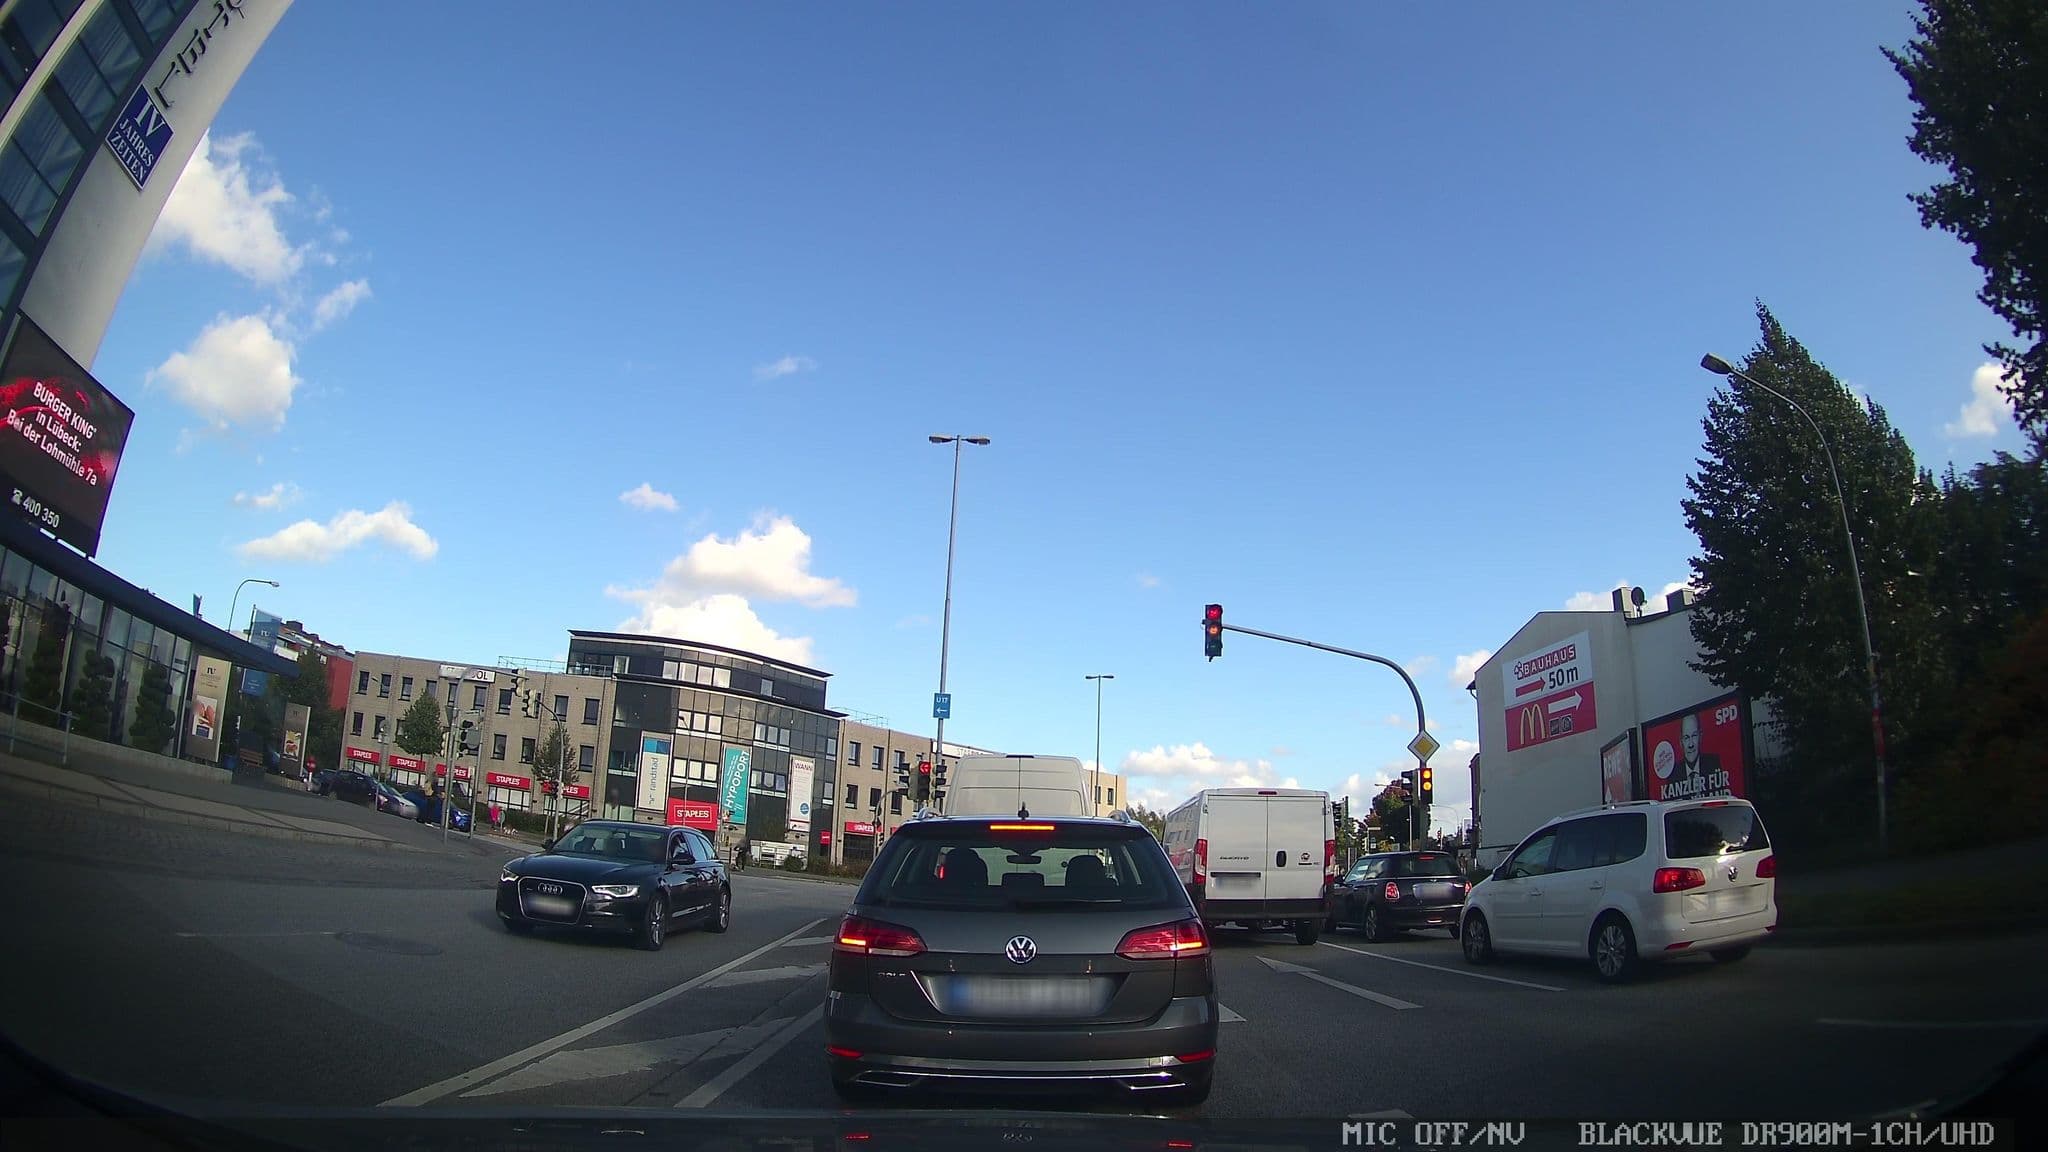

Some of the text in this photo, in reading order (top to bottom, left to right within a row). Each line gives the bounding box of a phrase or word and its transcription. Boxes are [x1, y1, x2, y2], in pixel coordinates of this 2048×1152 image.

[135, 97, 165, 137] IV
[111, 131, 147, 181] ZEITEN
[120, 119, 154, 167] JAHRES
[33, 381, 72, 423] BURGER
[36, 408, 82, 453] in Lübeck:
[6, 408, 98, 486] Bei der Lohmühle 7a
[22, 496, 60, 528] 400 350
[1523, 645, 1576, 676] BAUHAUS
[1548, 666, 1579, 690] 50 m
[1715, 705, 1738, 725] SPD
[353, 749, 373, 759] STAPLES
[396, 758, 417, 768] STAPLES
[496, 775, 521, 786] STAPLES
[724, 750, 750, 809] HYPOPORT
[1660, 775, 1707, 800] KANZLER
[1708, 768, 1730, 790] FÜR
[676, 809, 710, 819] STAPLES
